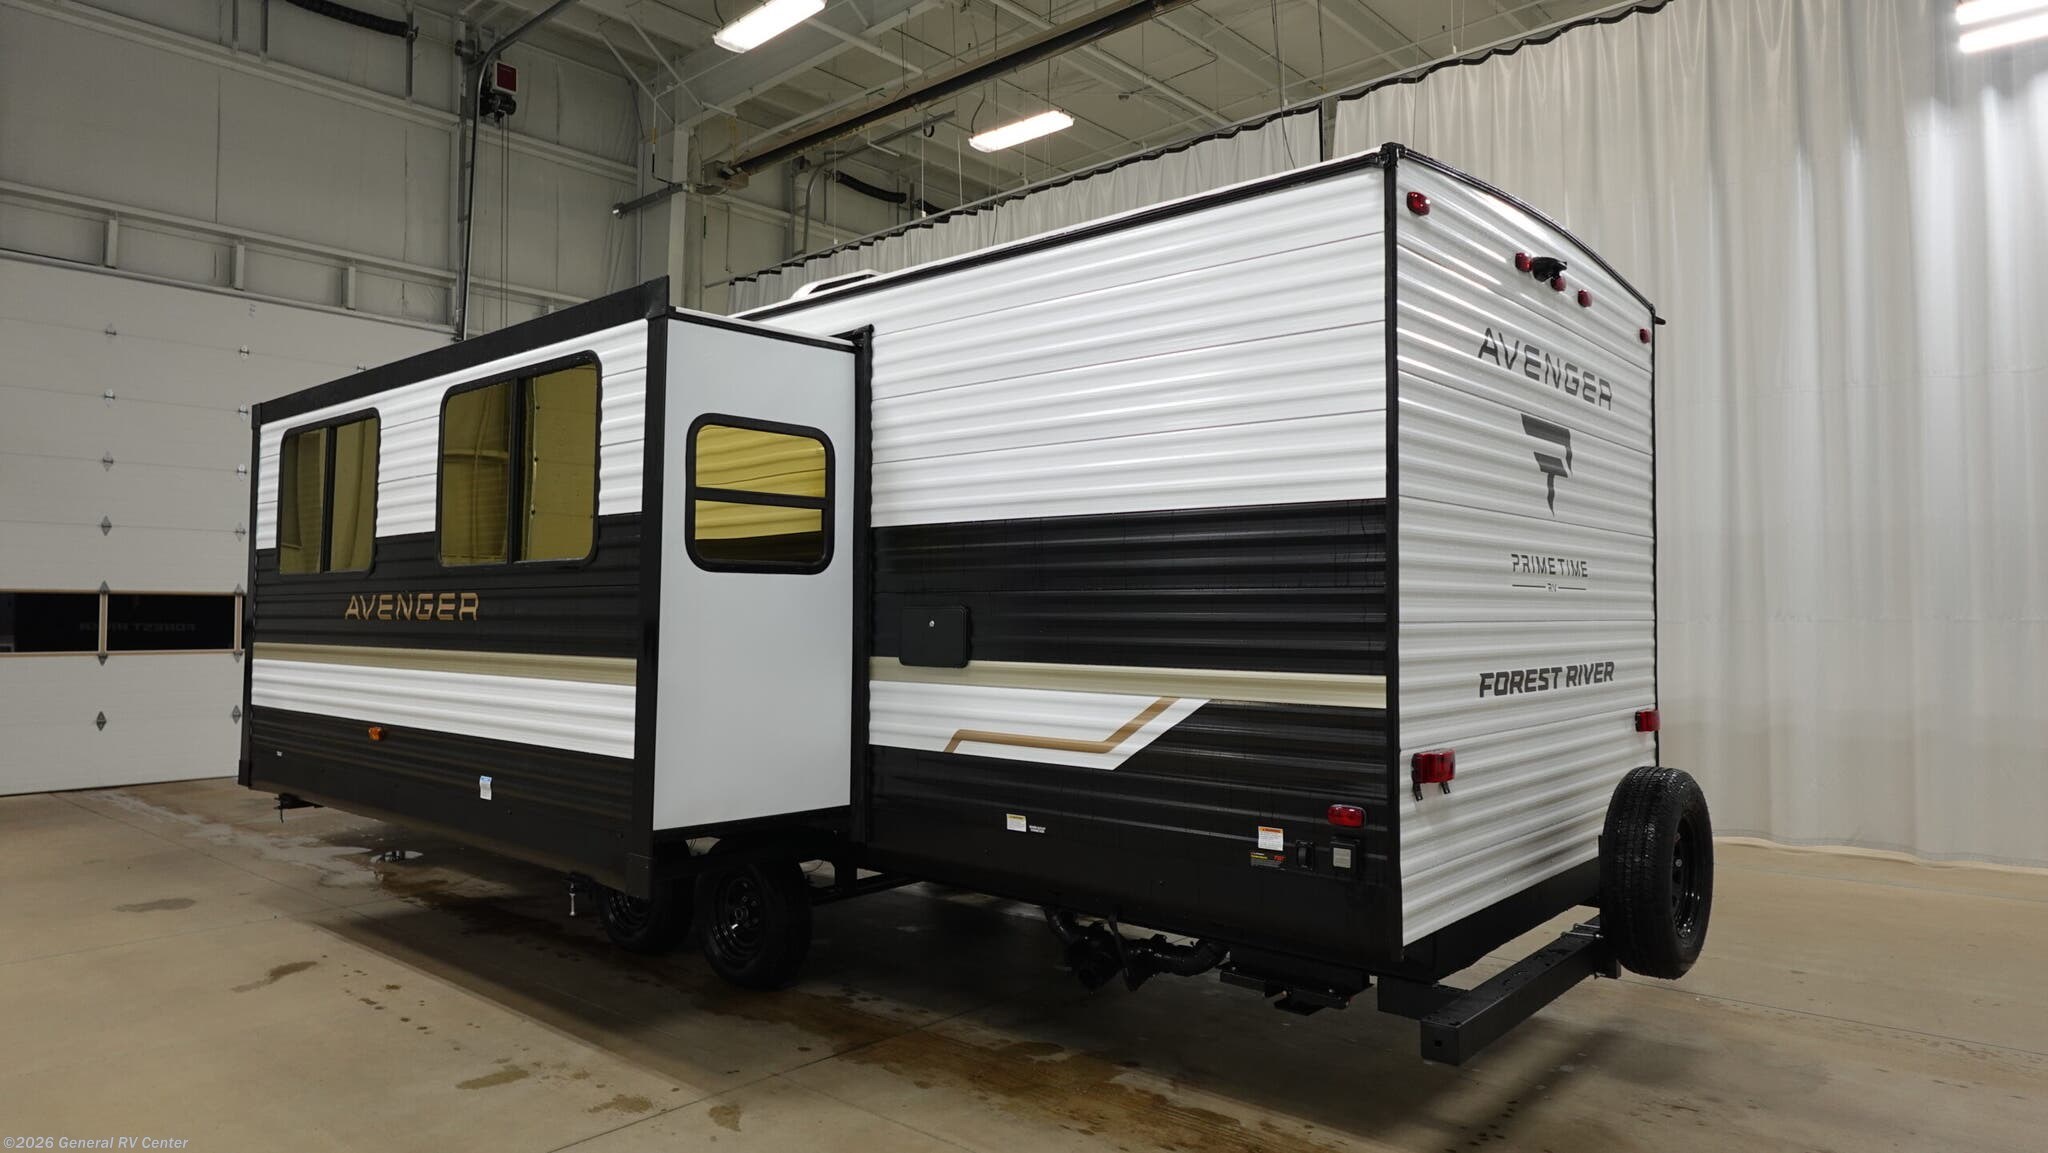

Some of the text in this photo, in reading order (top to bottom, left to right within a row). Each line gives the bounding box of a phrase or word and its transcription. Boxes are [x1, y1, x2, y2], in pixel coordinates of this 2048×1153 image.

[1478, 327, 1613, 411] AVENGER
[1511, 553, 1588, 578] PRIMETIME
[1547, 583, 1557, 592] RV
[344, 592, 480, 621] AVENGER
[1479, 661, 1615, 698] FOREST RIVER
